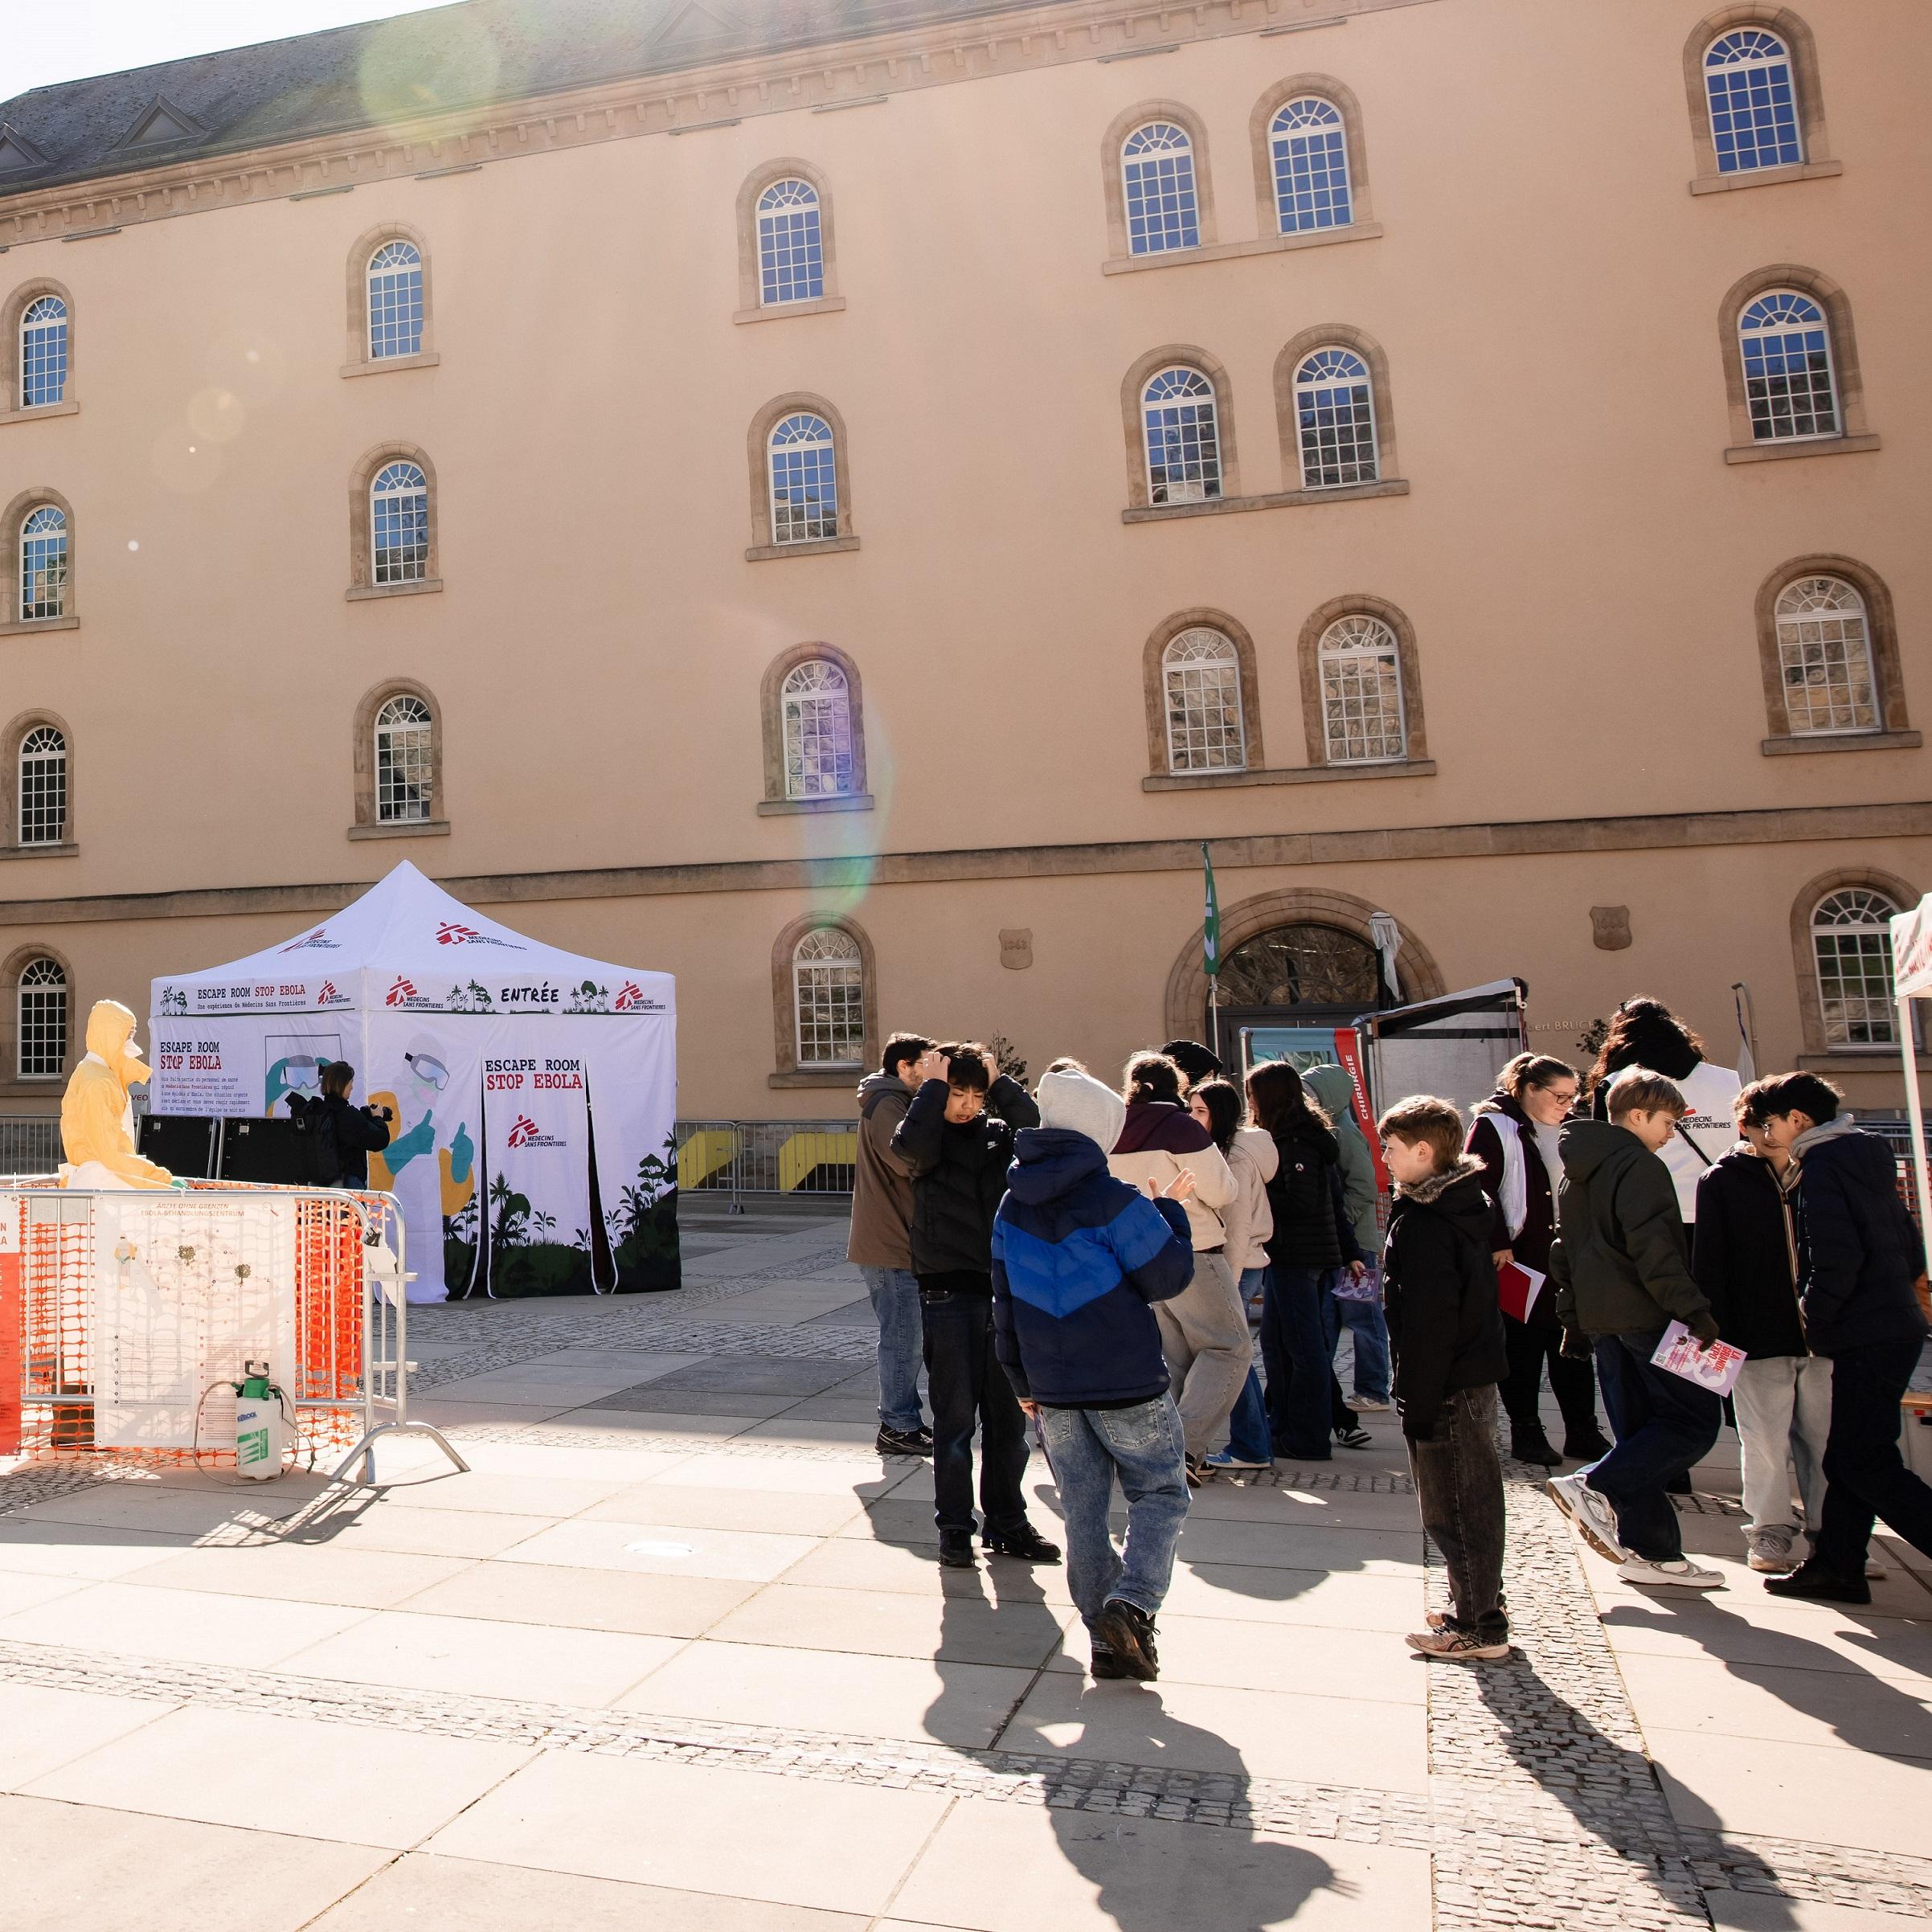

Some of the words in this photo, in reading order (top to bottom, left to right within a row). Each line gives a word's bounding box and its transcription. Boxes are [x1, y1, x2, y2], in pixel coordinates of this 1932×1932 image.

[198, 989, 226, 999] ESCAPE
[231, 987, 251, 997] ROOM
[255, 986, 275, 997] STOP
[280, 984, 305, 996] EBOLA
[501, 980, 559, 1003] ENTRÉE
[161, 1042, 192, 1053] ESCAPE
[198, 1042, 219, 1053] ROOM
[161, 1055, 183, 1070] STOP
[189, 1055, 222, 1070] EBOLA
[485, 1059, 536, 1071] ESCAPE
[545, 1059, 579, 1070] ROOM
[487, 1074, 524, 1090] STOP
[534, 1074, 583, 1089] EBOLA
[1345, 1054, 1369, 1119] CHIRURGIE
[1708, 1342, 1722, 1359] EXPO
[1730, 1350, 1742, 1362] LA
[1713, 1345, 1733, 1373] GRANDE
